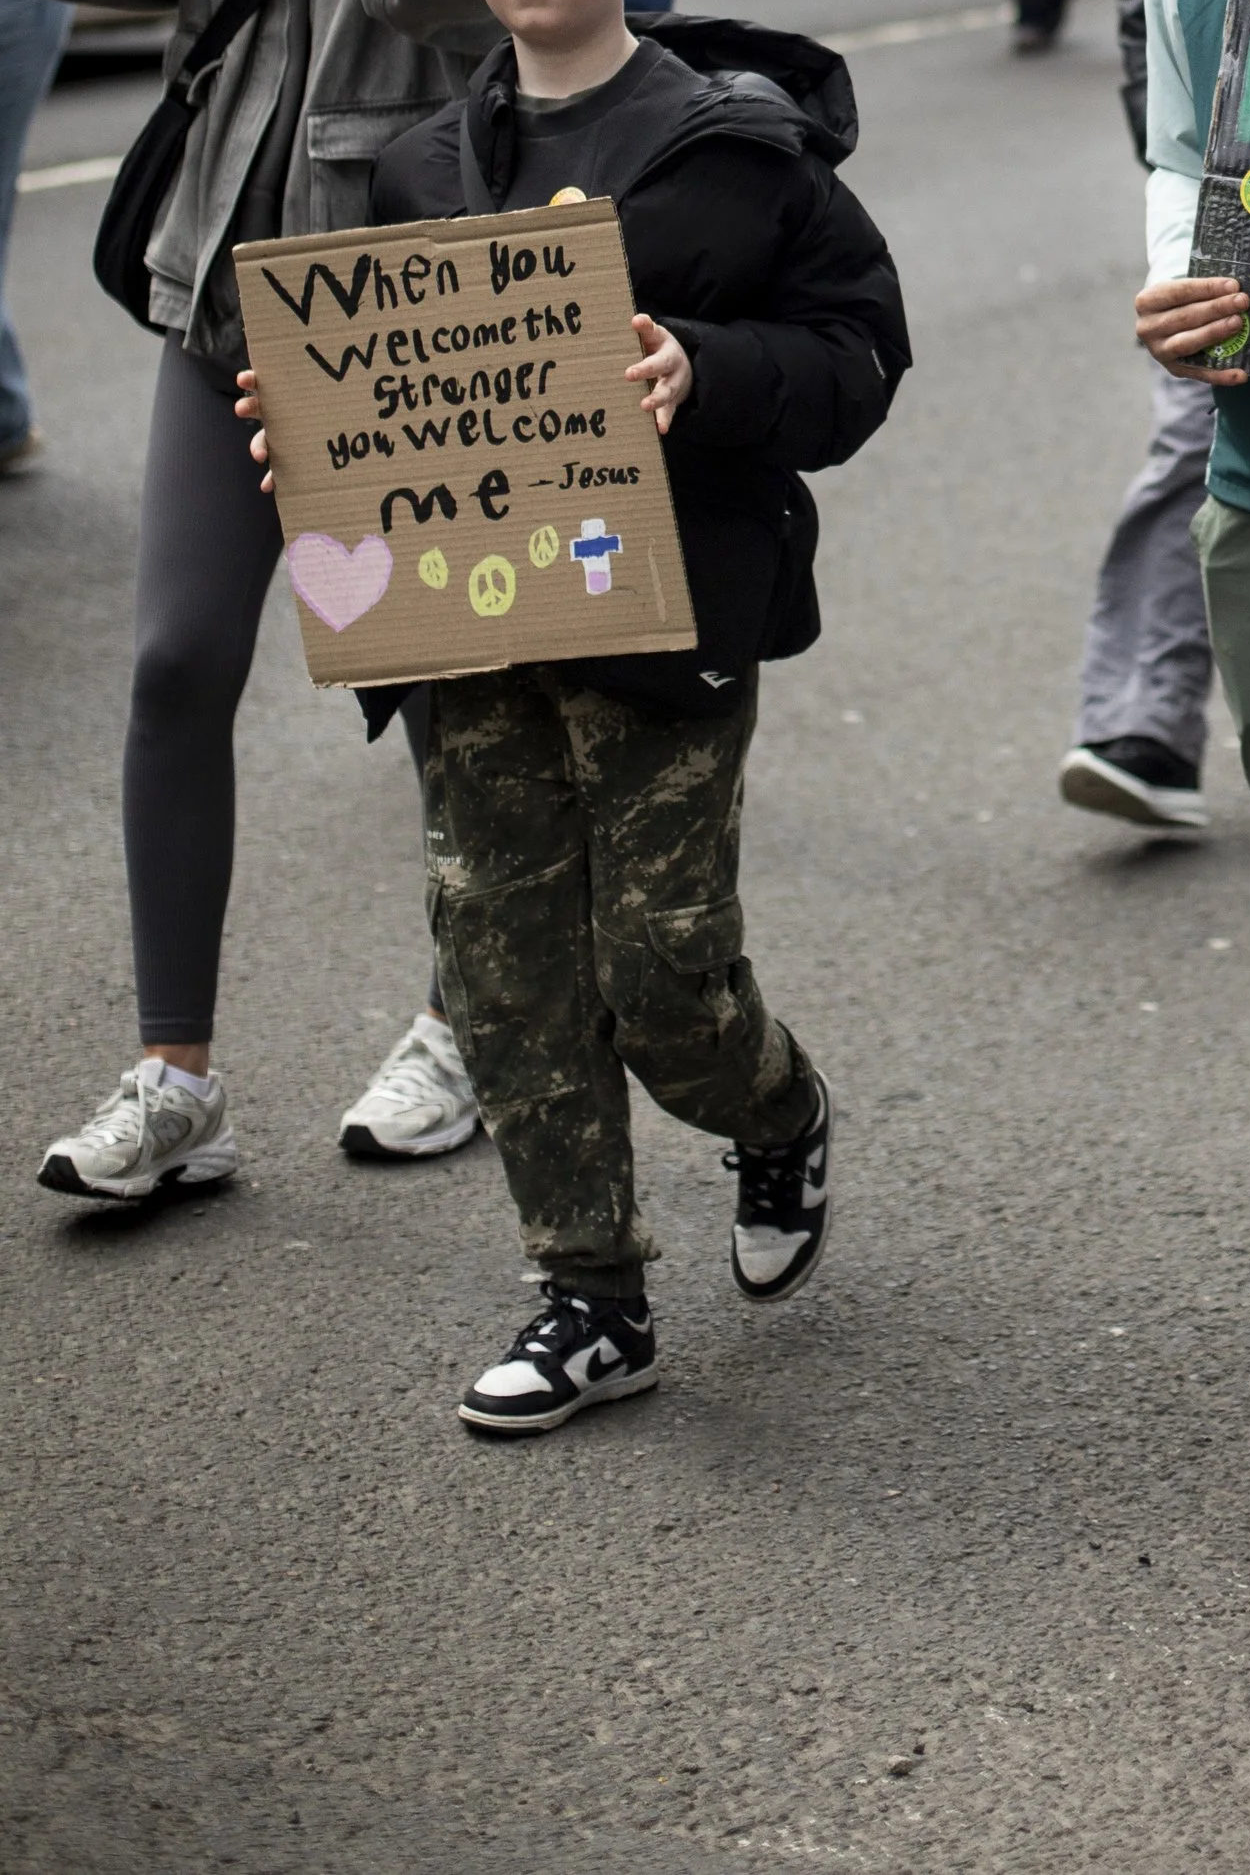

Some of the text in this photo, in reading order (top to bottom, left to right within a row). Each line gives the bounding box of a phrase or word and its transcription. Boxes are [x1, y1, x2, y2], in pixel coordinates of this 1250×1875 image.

[261, 253, 460, 326] When
[521, 301, 581, 341] the
[327, 430, 395, 470] you
[379, 469, 511, 534] me
